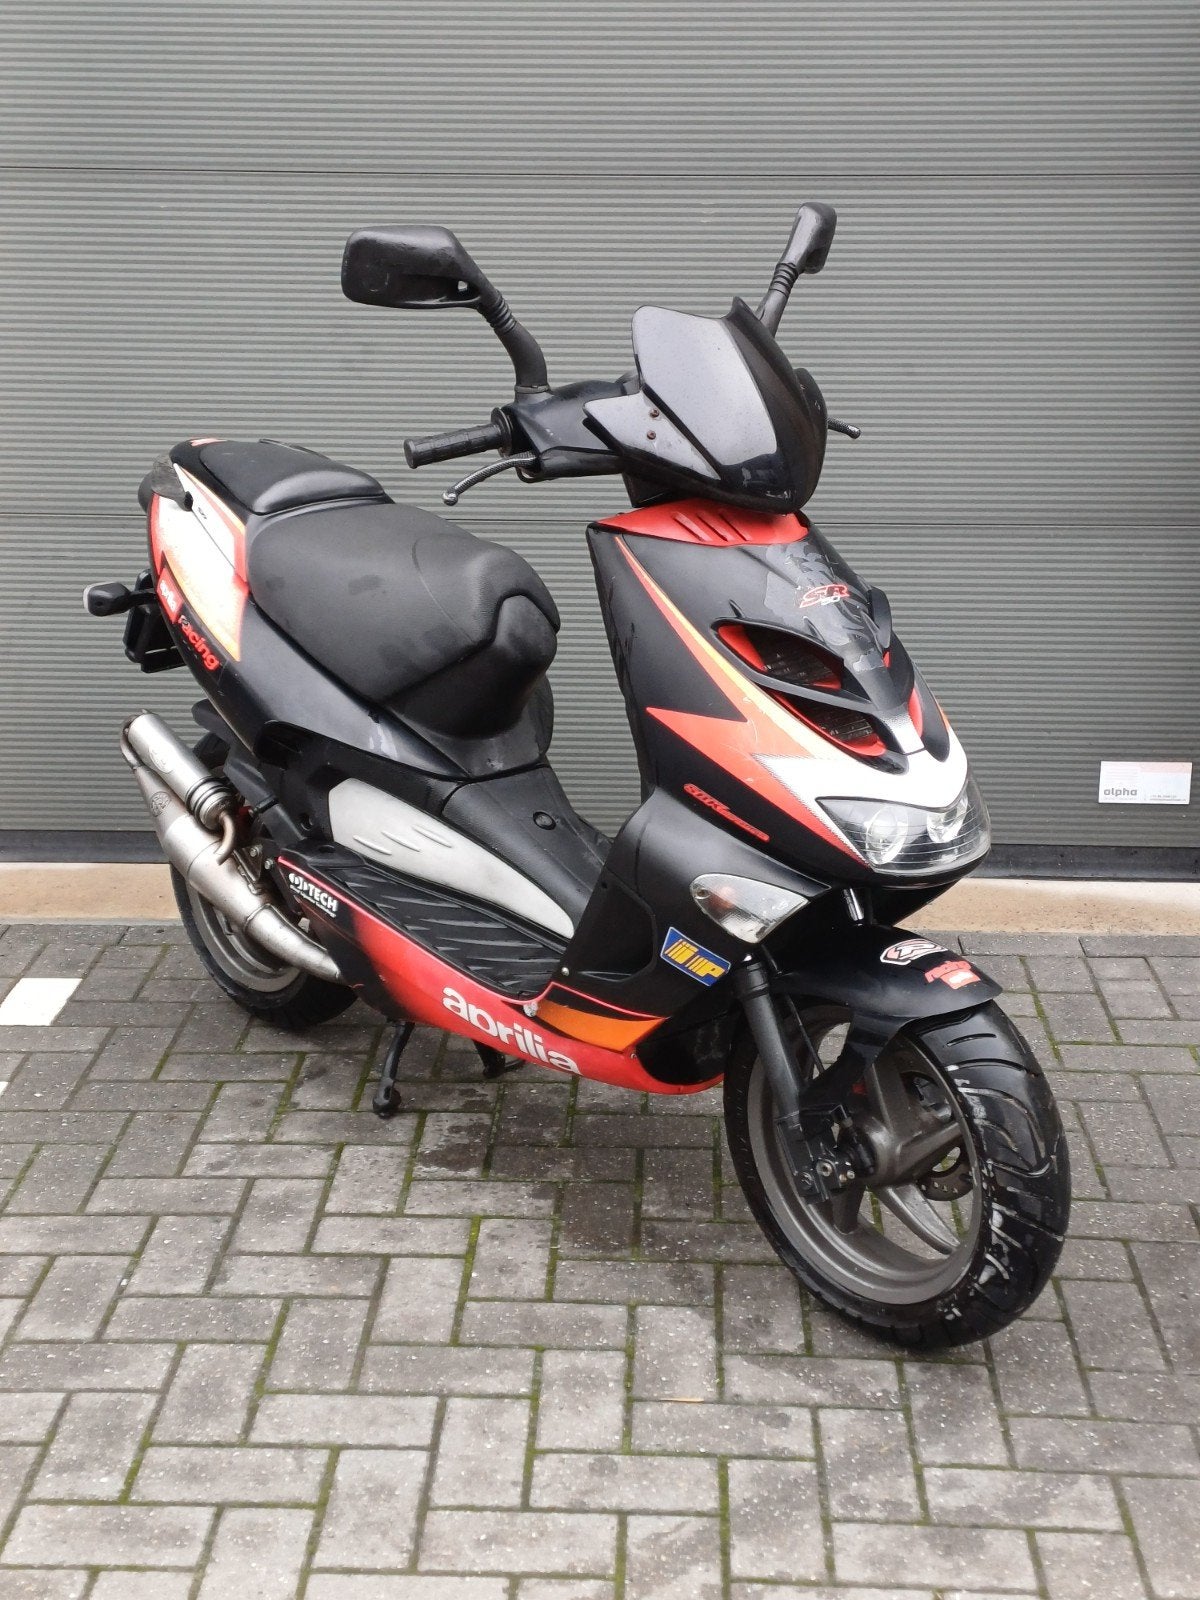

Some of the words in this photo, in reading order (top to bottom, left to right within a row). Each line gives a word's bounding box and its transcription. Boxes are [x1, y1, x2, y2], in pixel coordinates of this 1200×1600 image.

[799, 584, 850, 608] SR
[1103, 787, 1138, 797] alpha
[442, 986, 583, 1076] aprilia
